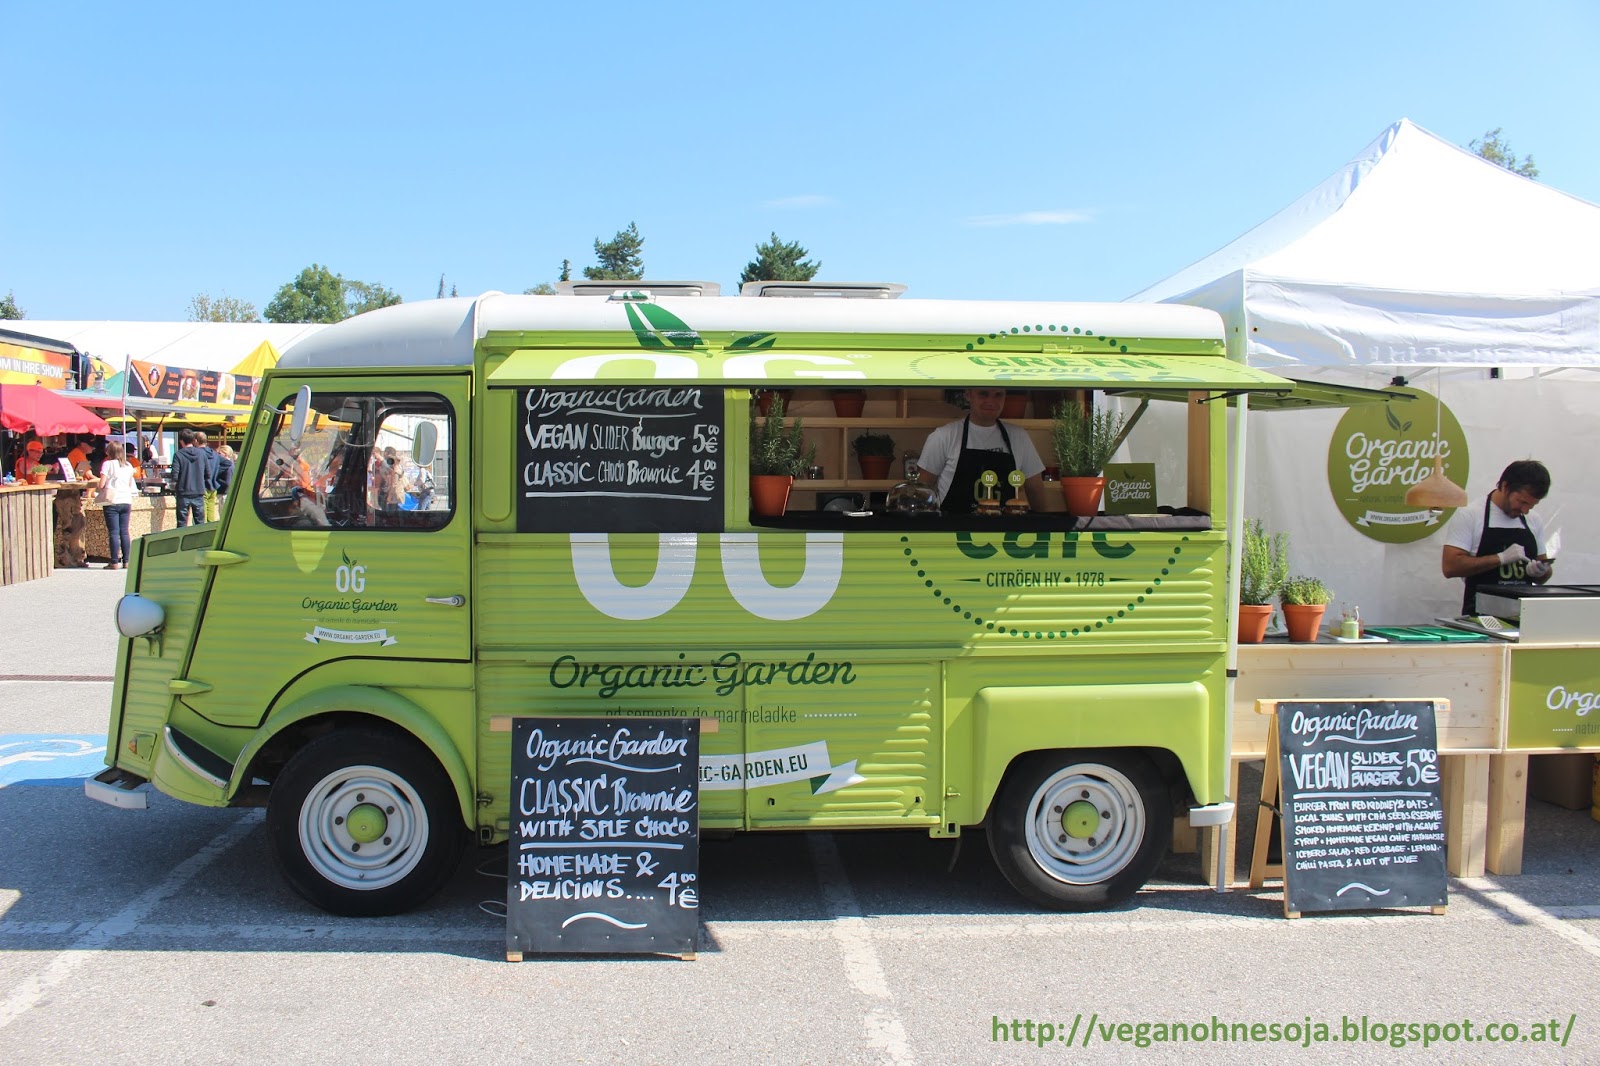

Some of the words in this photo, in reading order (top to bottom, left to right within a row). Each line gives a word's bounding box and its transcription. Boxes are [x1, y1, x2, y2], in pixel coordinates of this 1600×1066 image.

[0, 358, 11, 370] M
[13, 359, 21, 372] IN
[22, 360, 40, 375] IHRE
[41, 364, 64, 379] SHOW
[968, 356, 1167, 370] GREEN
[525, 388, 616, 418] Organic
[616, 388, 704, 412] Garden
[525, 423, 589, 451] VEGAN
[590, 423, 630, 452] SLIDER
[631, 424, 686, 458] Burger
[1345, 432, 1451, 467] Organic
[524, 457, 595, 487] CLASSiC
[598, 459, 625, 484] CHOCO
[626, 459, 684, 486] Brownie
[985, 474, 994, 482] OG
[1012, 474, 1021, 482] OG
[1108, 479, 1152, 493] Organic
[1110, 489, 1151, 503] Garden
[335, 565, 366, 593] OG
[986, 569, 1041, 587] CITRÖEN
[1044, 572, 1061, 587] HY
[1075, 572, 1105, 587] 1978
[302, 597, 350, 613] Organic
[352, 598, 398, 613] Garden
[550, 652, 708, 698] Organic
[711, 652, 857, 697] Garden
[714, 705, 797, 723] marmeladke
[1291, 710, 1357, 747] Organic
[1355, 708, 1418, 740] Garden
[526, 728, 609, 771] Organic
[608, 727, 688, 762] Garden
[699, 753, 809, 782] IC-GARDEN.EU
[1288, 750, 1349, 790] VEGAN
[1351, 751, 1406, 766] SLIDER
[1352, 771, 1403, 788] BURGER
[519, 774, 609, 817] CLASSIC
[610, 776, 697, 817] Brownie
[1293, 801, 1328, 812] BURGER
[1328, 800, 1350, 811] FROM
[1351, 800, 1366, 810] RED
[1406, 800, 1428, 809] OATS
[1294, 813, 1320, 824] LOCAL
[1319, 813, 1344, 822] BUNS
[1345, 812, 1367, 822] WITH
[1387, 811, 1411, 821] SEEDS
[519, 819, 575, 838] WITH
[579, 819, 631, 840] 3PLE
[1295, 825, 1325, 836] SMOKED
[1326, 824, 1363, 834] HOMEMADE
[1363, 822, 1394, 833] KETCHUP
[1395, 822, 1413, 832] WITH
[1414, 822, 1441, 831] AGAVE
[1293, 836, 1319, 847] SYRUP
[1325, 834, 1364, 845] HOMEMADE
[1364, 833, 1388, 843] VEGAN
[1295, 848, 1327, 859] ICEBERG
[1327, 847, 1351, 857] SALAD
[1354, 845, 1370, 855] RED
[1372, 845, 1406, 854] CABBAGE
[636, 851, 660, 878] &
[1318, 859, 1345, 869] PASTA
[1346, 858, 1352, 868] &
[1354, 858, 1361, 867] A
[1363, 857, 1378, 866] LOT
[1379, 856, 1391, 866] OF
[1393, 854, 1418, 864] LOVE
